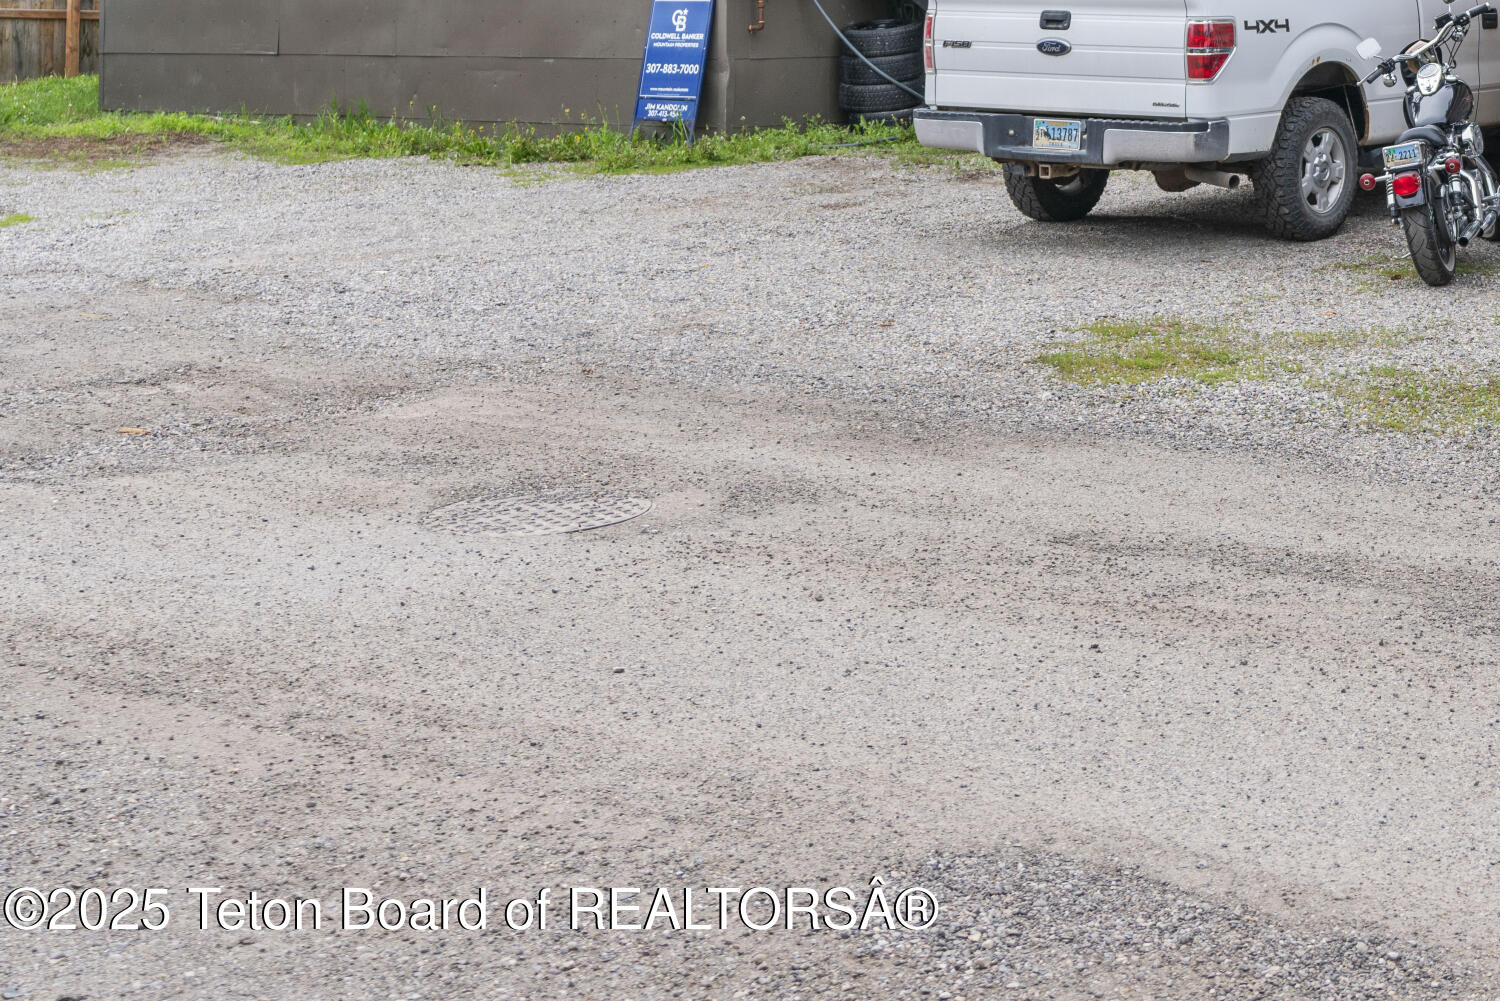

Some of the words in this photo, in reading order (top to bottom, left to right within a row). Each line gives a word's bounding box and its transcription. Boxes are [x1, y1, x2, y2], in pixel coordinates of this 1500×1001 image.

[651, 32, 680, 40] COLDWELL
[1042, 42, 1061, 52] Ford
[646, 63, 699, 74] 307-883-7000
[1052, 127, 1078, 142] 13787
